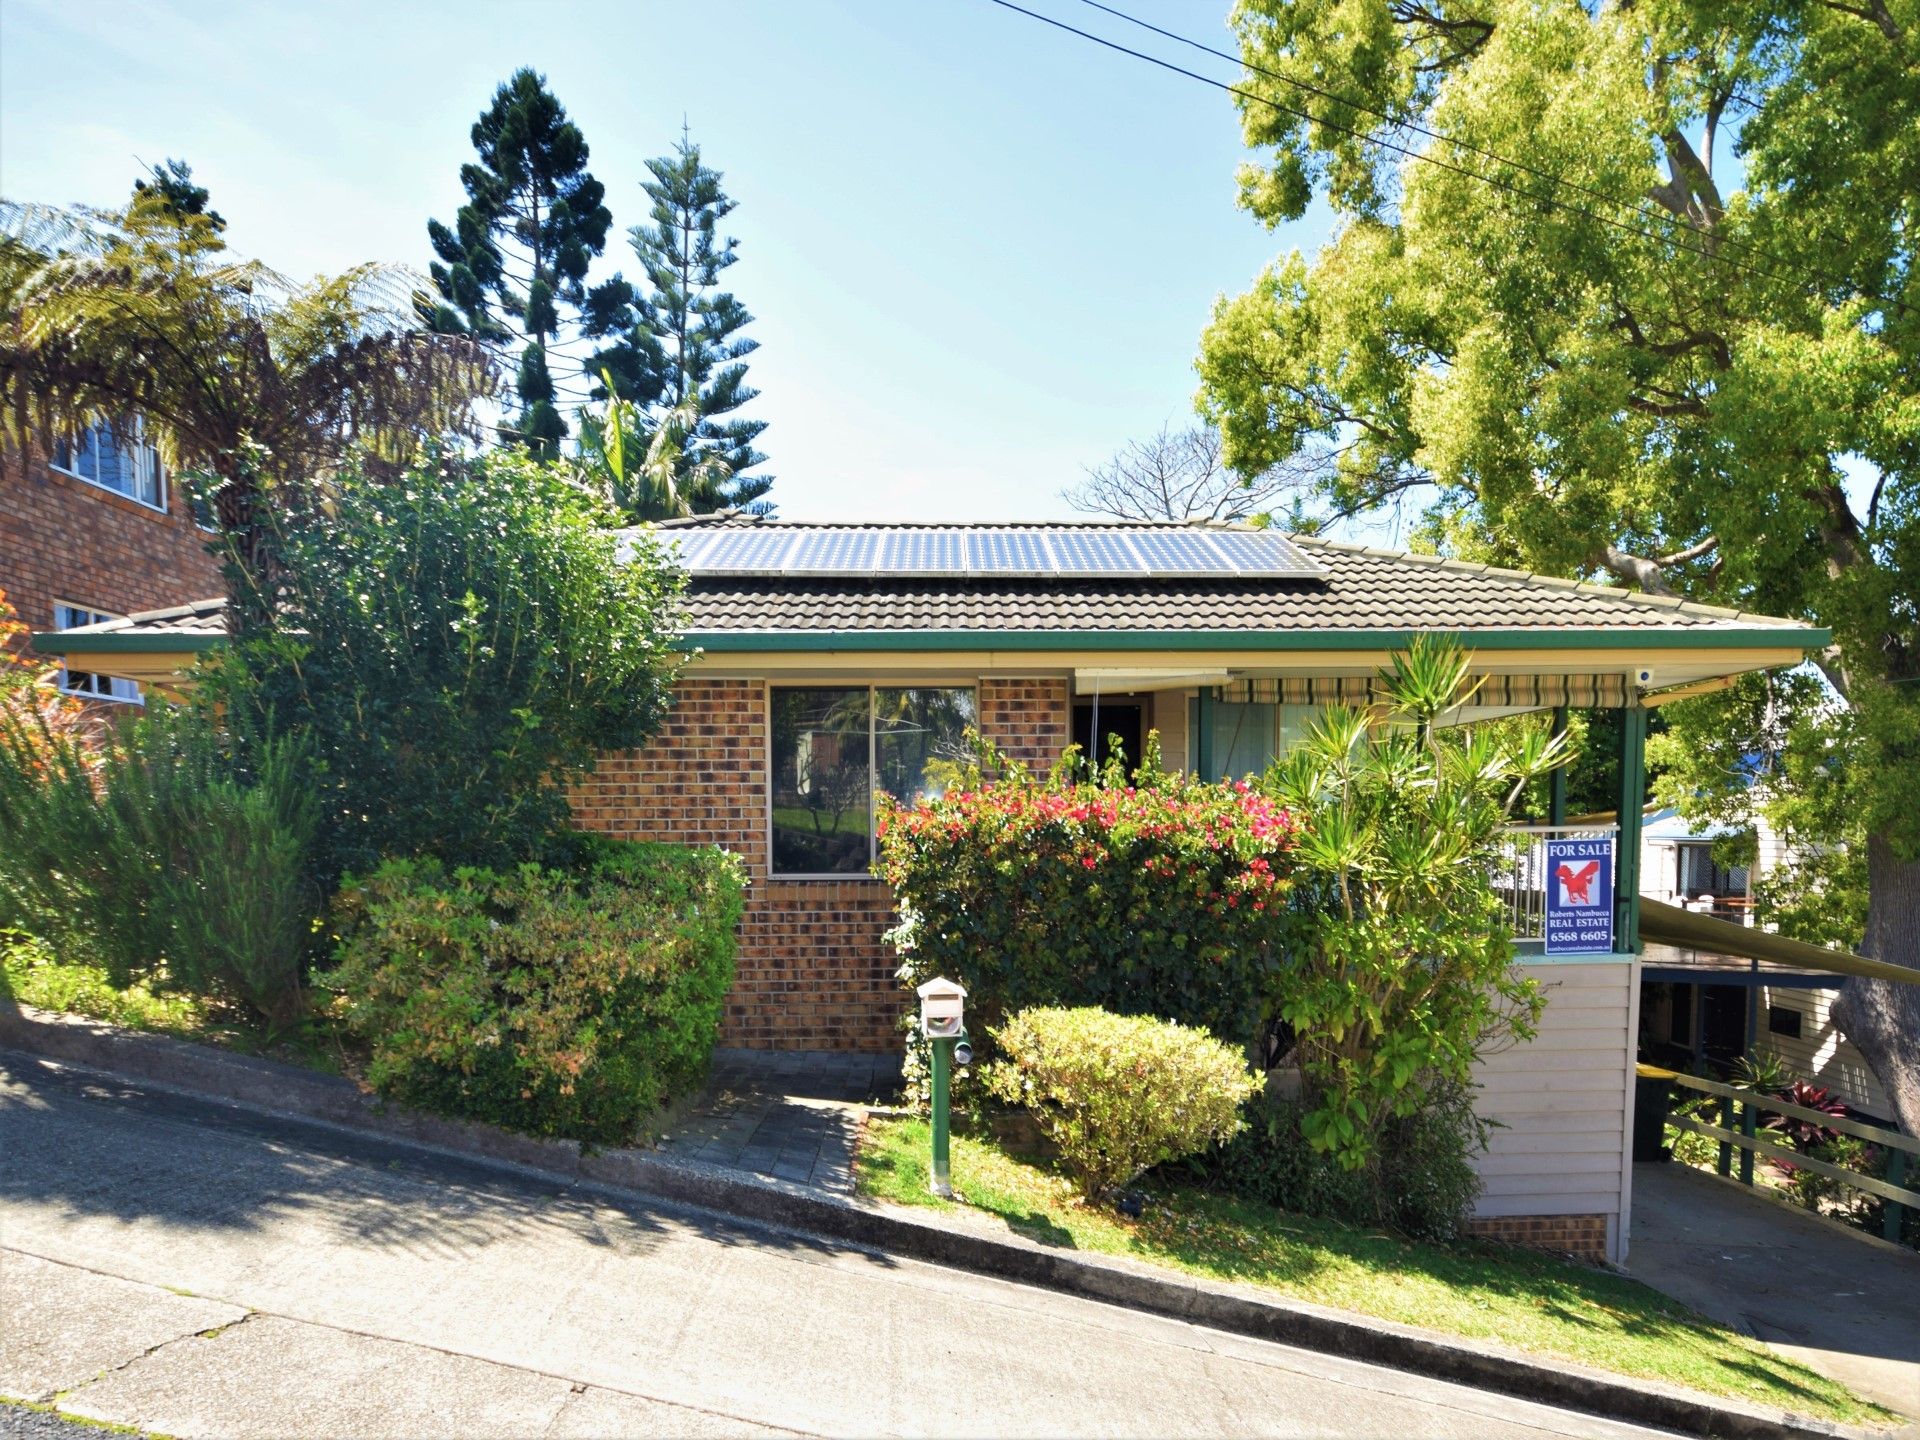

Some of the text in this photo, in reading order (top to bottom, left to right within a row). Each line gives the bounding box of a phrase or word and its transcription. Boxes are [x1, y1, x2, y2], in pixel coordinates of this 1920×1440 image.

[1550, 844, 1610, 856] FOR SALE
[1550, 918, 1609, 928] REAL ESTATE
[1551, 931, 1608, 942] 6568 6605
